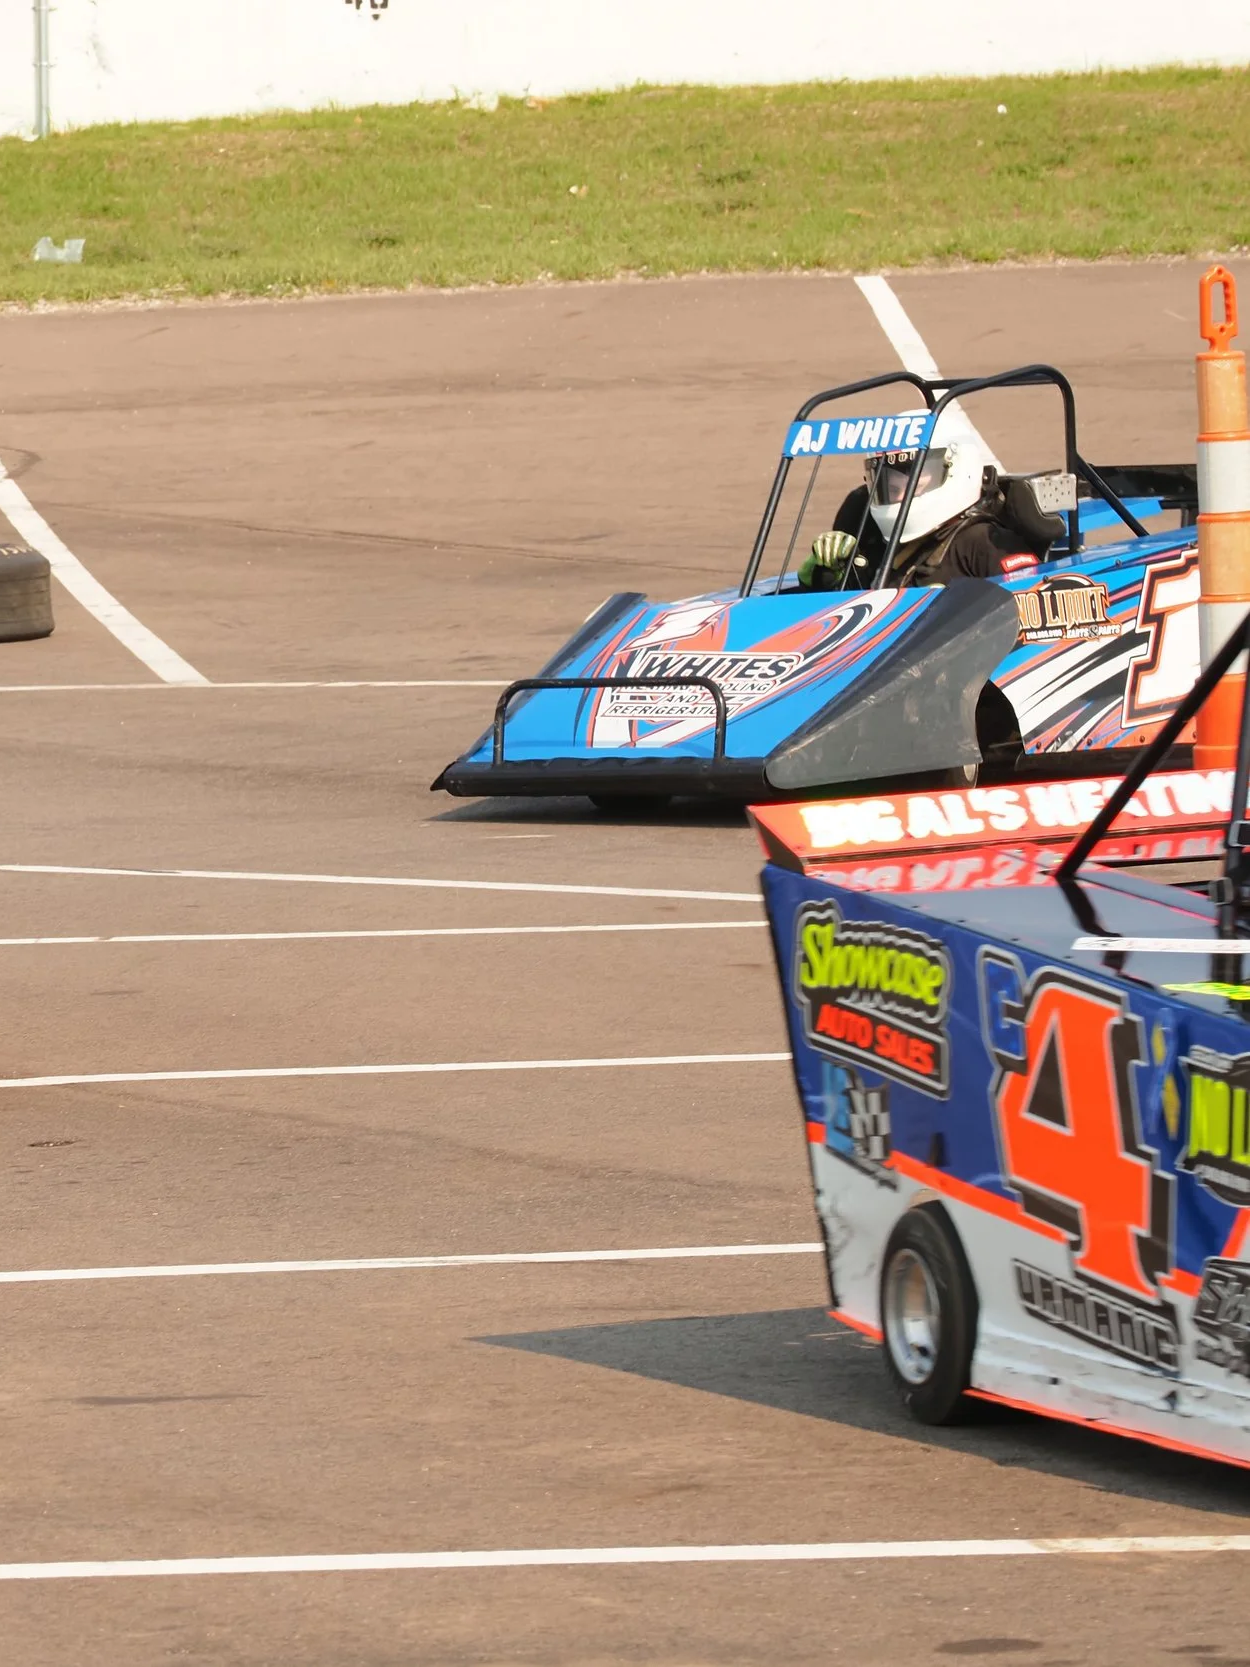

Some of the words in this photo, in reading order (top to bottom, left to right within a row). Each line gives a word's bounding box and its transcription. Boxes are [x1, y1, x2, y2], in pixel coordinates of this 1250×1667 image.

[790, 422, 830, 455] AJ
[837, 417, 926, 449] WHITE
[1041, 587, 1106, 629] LIMIT
[638, 654, 802, 680] WHITES
[665, 694, 700, 704] AND
[799, 800, 904, 848] BIG
[906, 788, 1029, 838] AL'S
[801, 923, 946, 1006] Showcase
[816, 1004, 873, 1049] AUTO
[874, 1025, 935, 1074] SALES
[998, 985, 1162, 1298] 4
